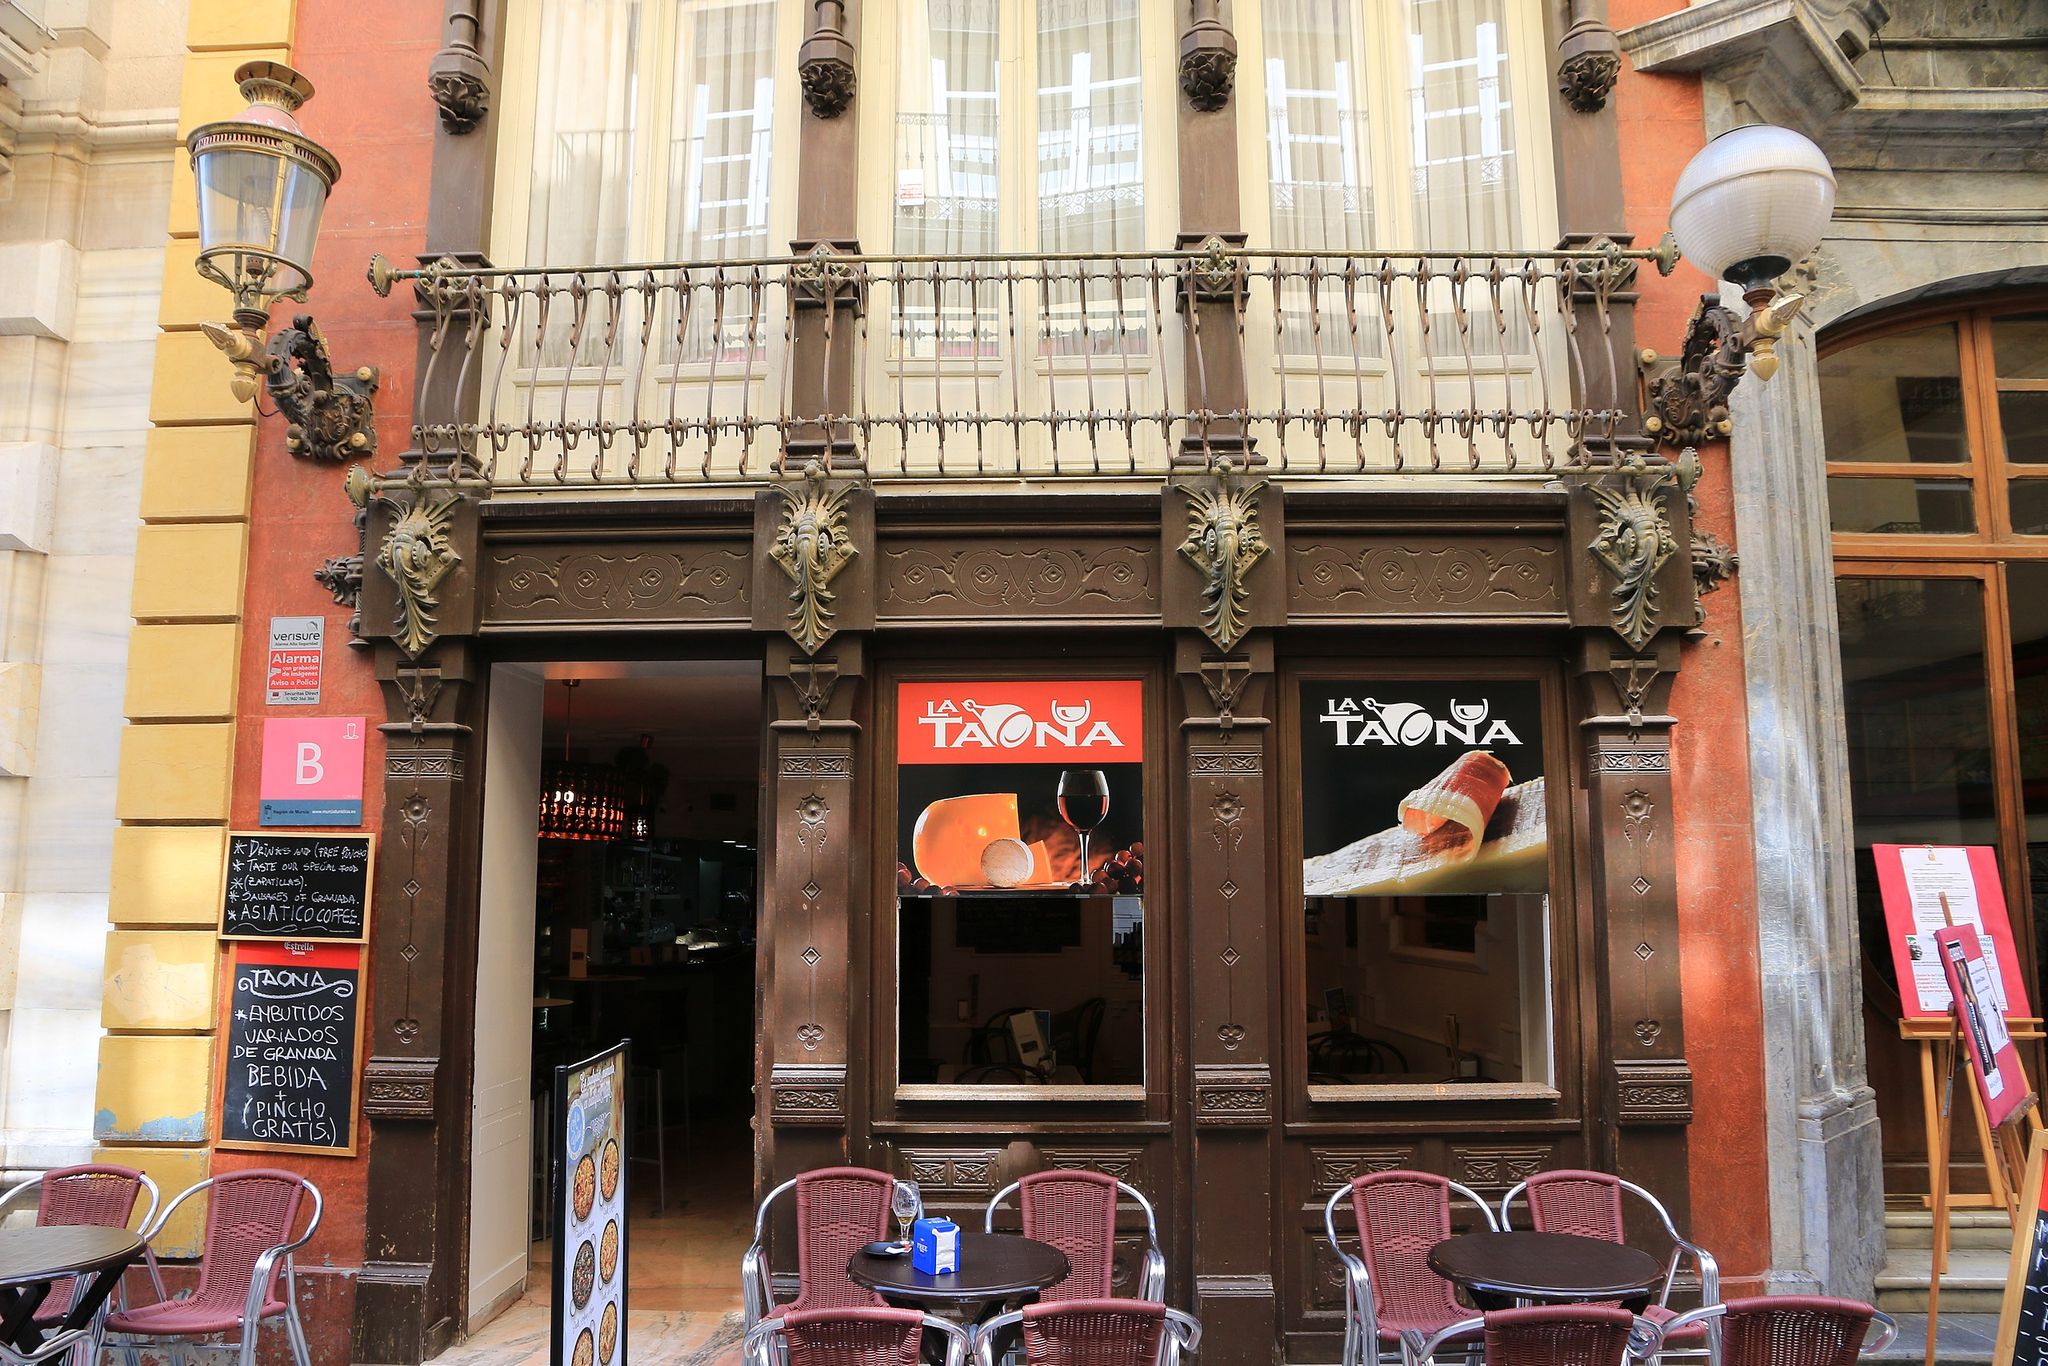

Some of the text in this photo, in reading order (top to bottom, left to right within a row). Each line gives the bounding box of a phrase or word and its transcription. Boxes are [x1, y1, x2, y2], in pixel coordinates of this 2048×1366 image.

[273, 632, 321, 641] verisure
[271, 652, 319, 664] Alarma
[927, 699, 959, 718] LA
[1328, 697, 1361, 716] LA
[295, 742, 324, 785] B
[247, 858, 277, 872] TASTE
[281, 861, 299, 872] OUR
[249, 968, 327, 988] TAONA
[233, 1045, 337, 1061] DE GRANADA
[246, 1063, 328, 1090] BEBIDA
